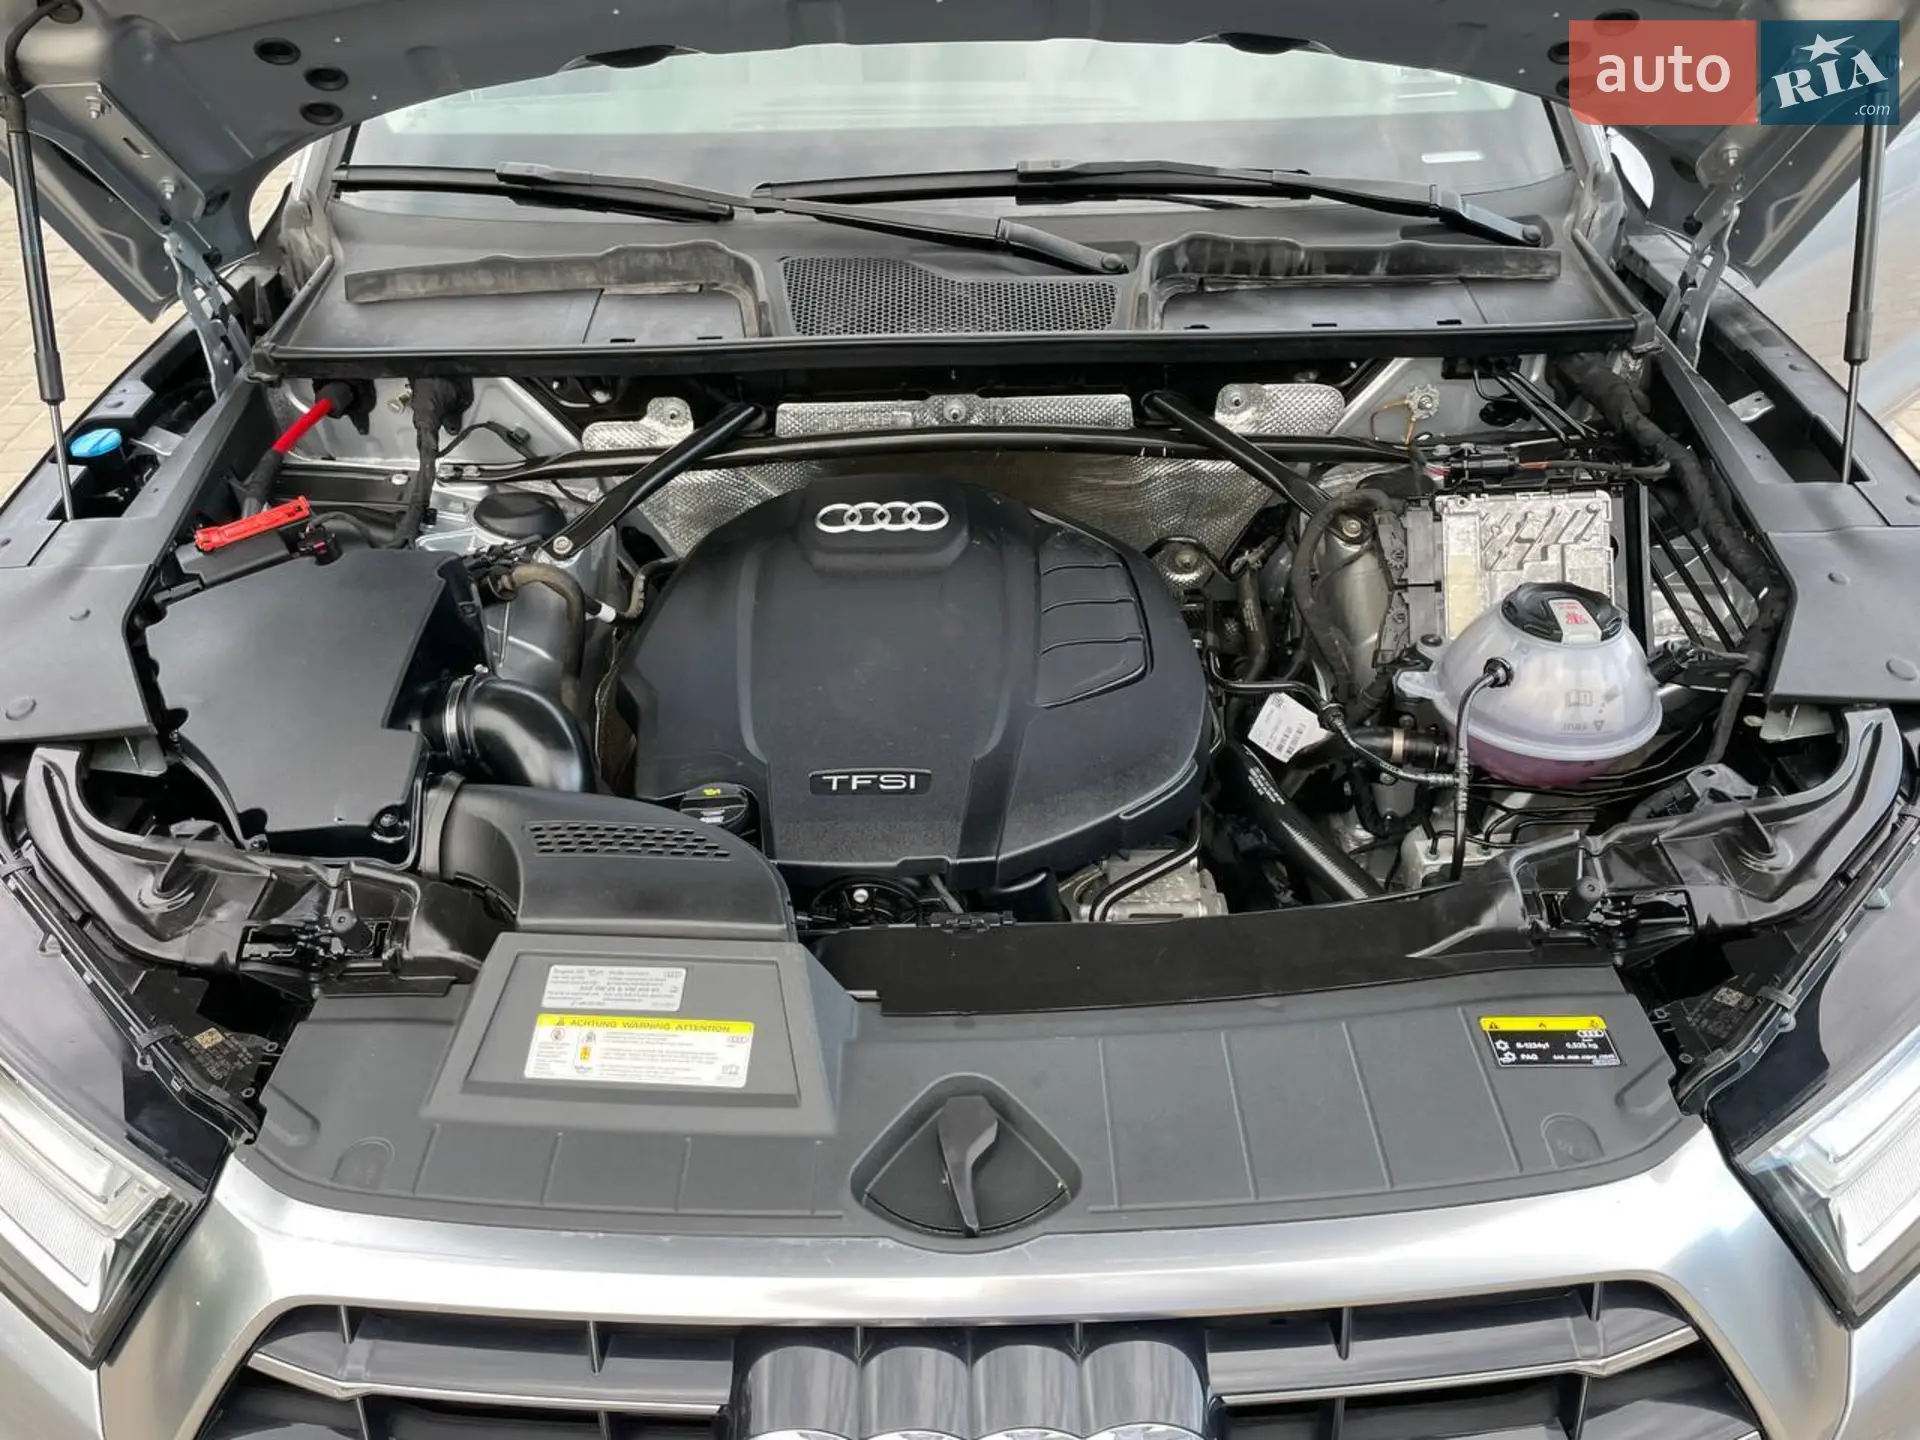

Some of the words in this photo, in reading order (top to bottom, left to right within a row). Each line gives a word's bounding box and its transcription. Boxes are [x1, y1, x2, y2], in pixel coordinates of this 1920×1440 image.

[822, 774, 916, 791] TFSI
[570, 1019, 617, 1029] ACHTUNG
[622, 1021, 671, 1031] WARNING
[675, 1023, 731, 1033] ATTENTION
